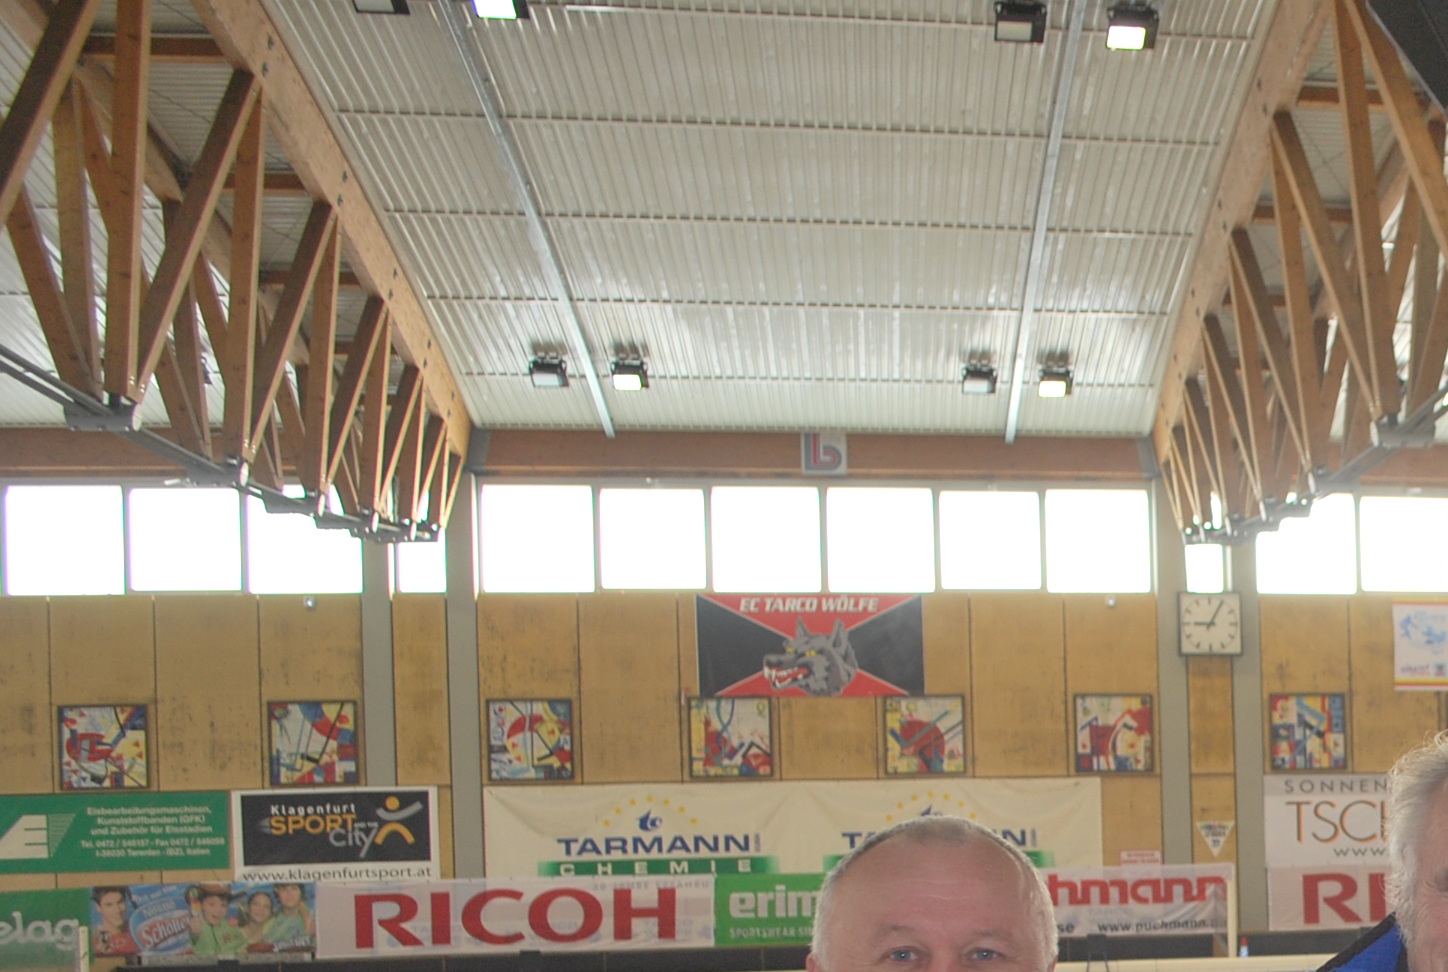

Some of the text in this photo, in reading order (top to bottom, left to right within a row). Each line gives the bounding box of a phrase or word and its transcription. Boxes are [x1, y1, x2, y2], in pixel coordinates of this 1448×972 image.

[740, 594, 879, 613] EC TARCO WÖLFE
[1284, 778, 1388, 794] SONNEN
[270, 802, 356, 817] Klagenfurt
[90, 826, 109, 836] und
[111, 825, 147, 836] Zubehör
[150, 825, 164, 835] für
[269, 814, 357, 836] SPORT
[329, 826, 379, 858] City
[557, 834, 750, 857] TARMANN
[243, 866, 432, 882] www.klagenfurtsport.at
[559, 859, 752, 877] CHEMIE
[354, 887, 677, 949] RICOH
[730, 926, 795, 939] SPORTSWEAR
